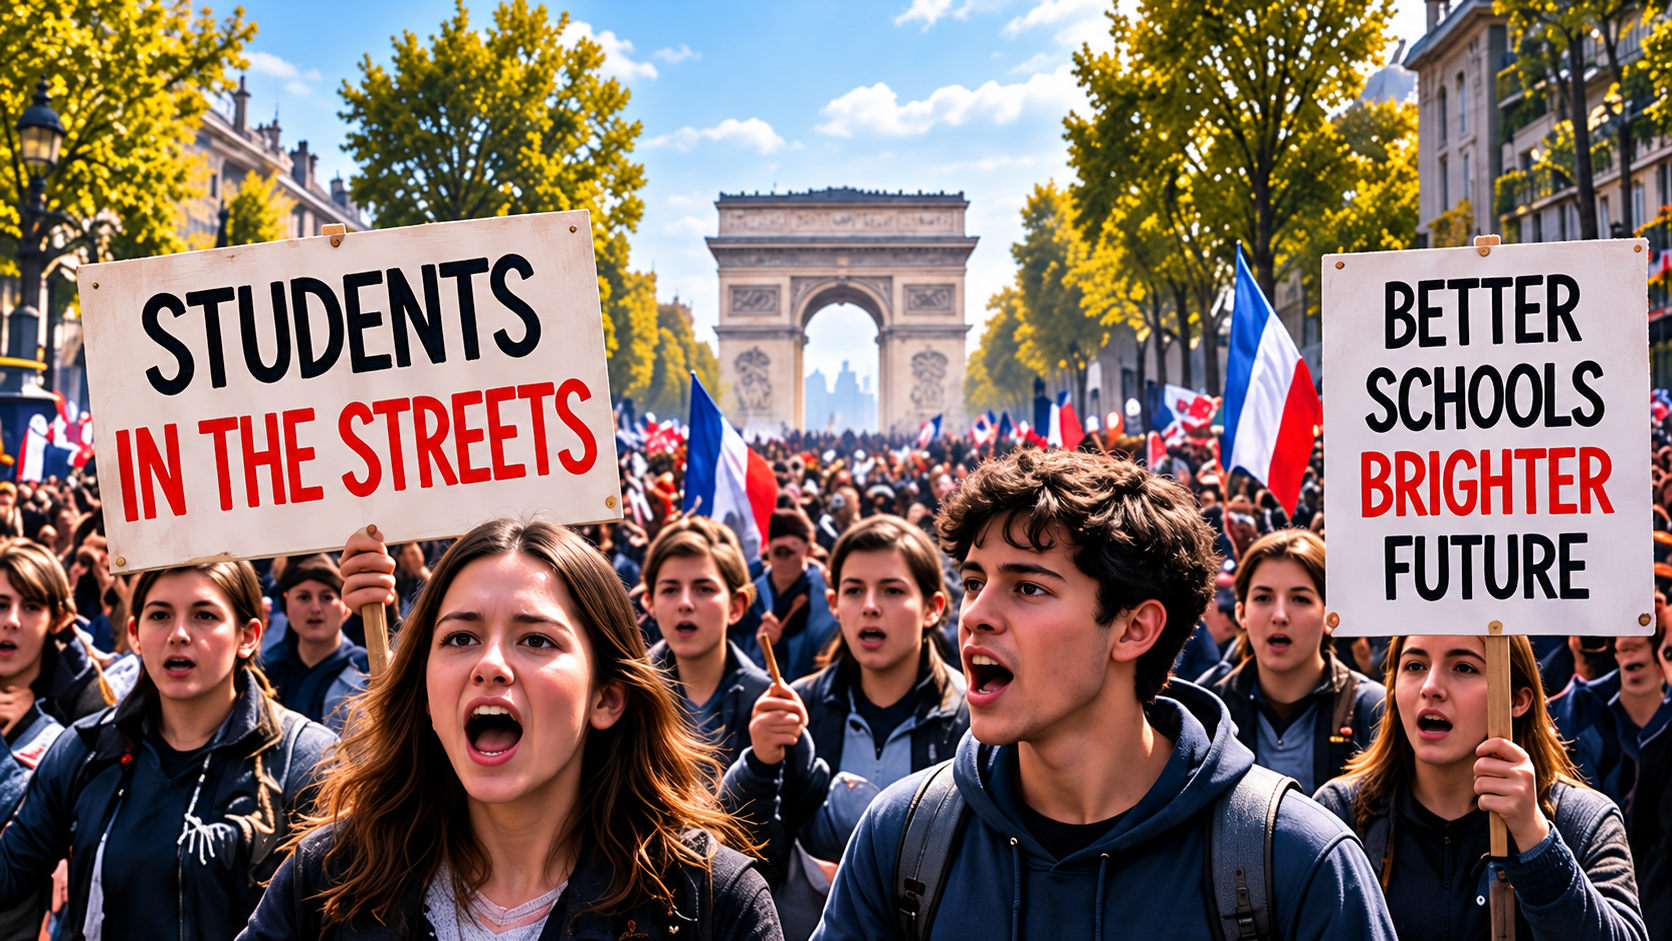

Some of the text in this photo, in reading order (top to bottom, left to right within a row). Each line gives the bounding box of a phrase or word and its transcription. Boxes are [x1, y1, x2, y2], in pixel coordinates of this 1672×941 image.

[141, 253, 542, 396] STUDENTS
[1384, 273, 1583, 350] BETTER
[1364, 360, 1605, 434] SCHOOLS
[115, 377, 598, 523] IN THE STREETS
[1360, 446, 1615, 518] BRIGHTER
[1384, 532, 1590, 602] FUTURE
